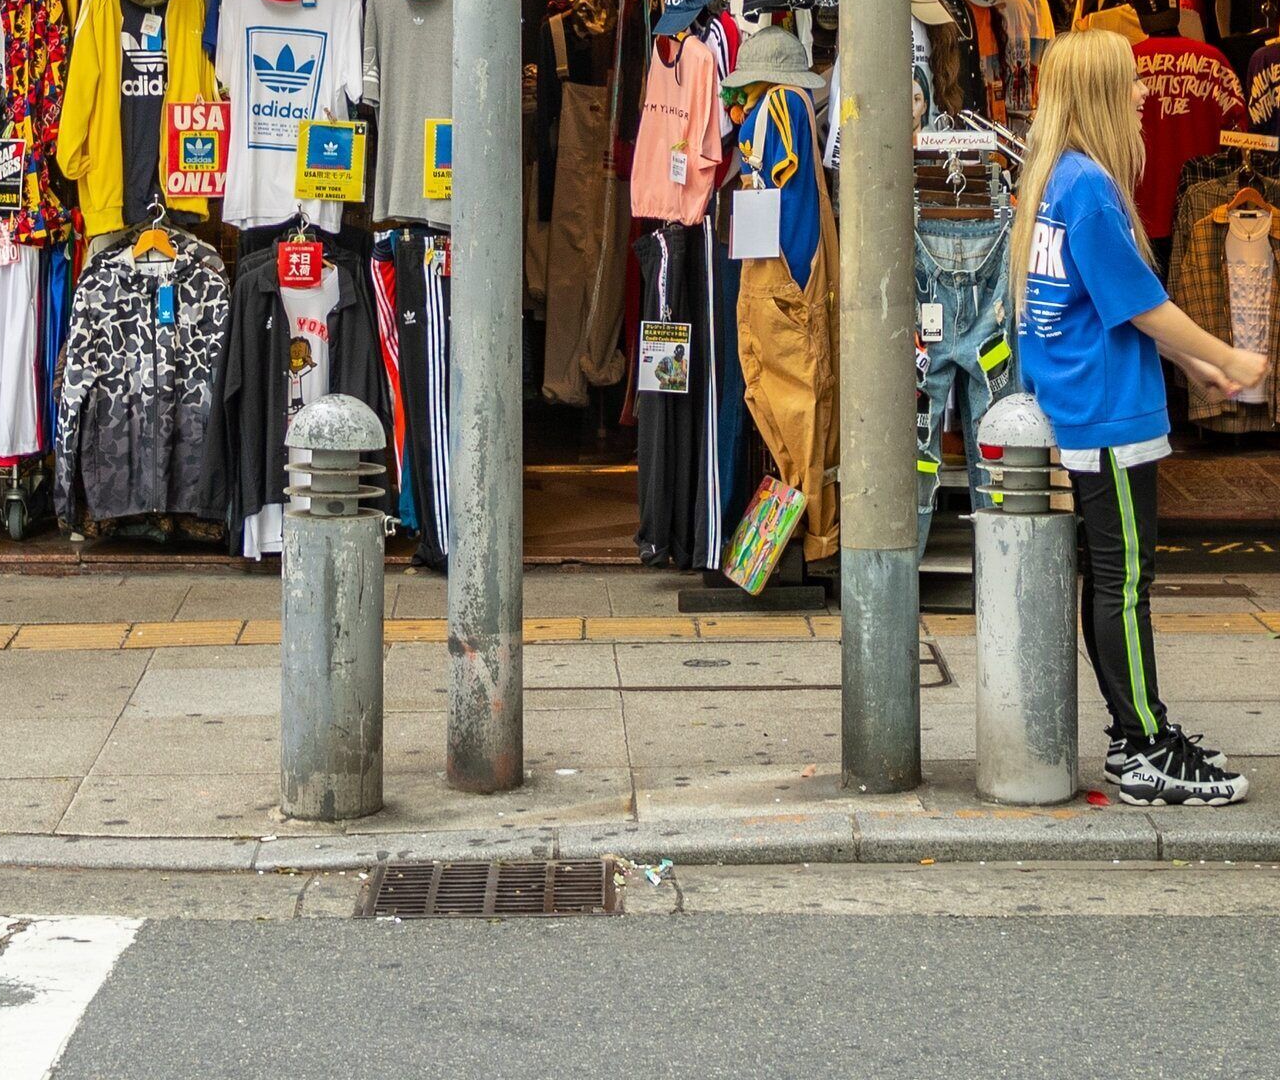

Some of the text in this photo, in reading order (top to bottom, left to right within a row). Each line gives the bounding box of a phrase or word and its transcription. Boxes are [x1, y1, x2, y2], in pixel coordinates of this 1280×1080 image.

[122, 75, 167, 96] adid
[1173, 97, 1191, 115] BE
[174, 106, 224, 131] USA
[921, 134, 993, 146] New Arrival
[1222, 135, 1239, 144] New
[168, 172, 227, 194] ONLY
[289, 253, 311, 265] 本日
[289, 265, 311, 276] 入荷
